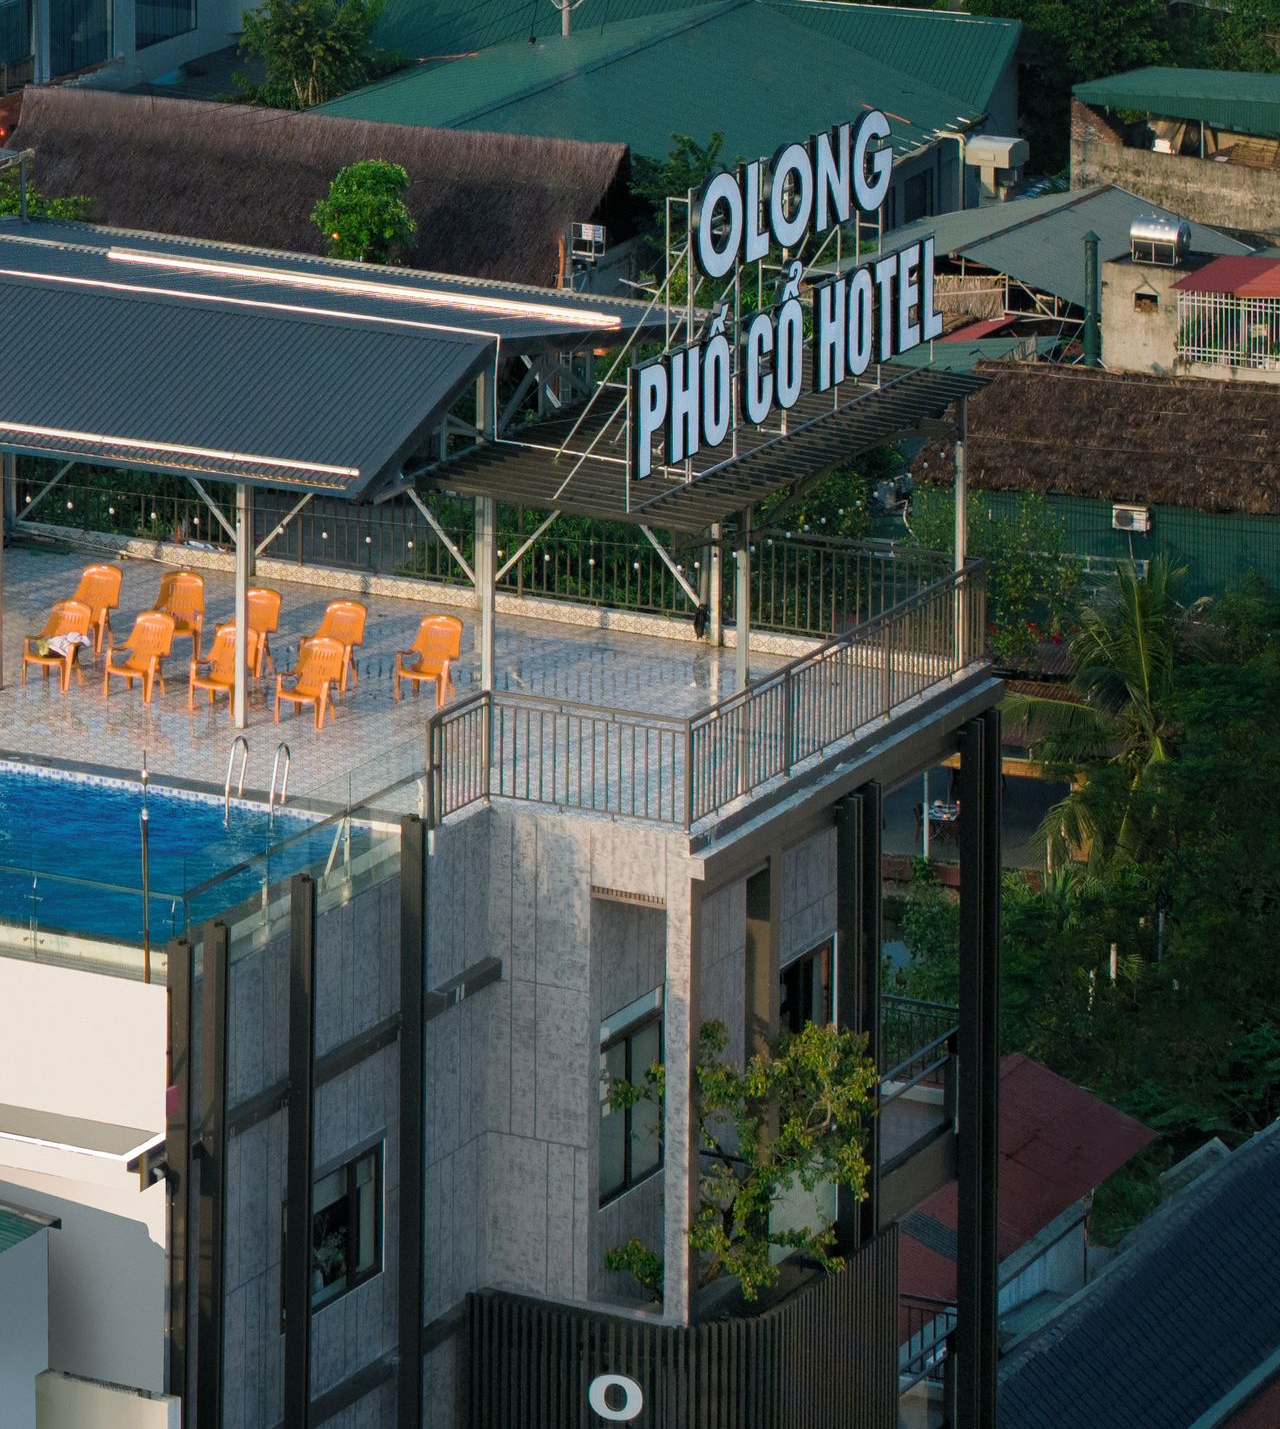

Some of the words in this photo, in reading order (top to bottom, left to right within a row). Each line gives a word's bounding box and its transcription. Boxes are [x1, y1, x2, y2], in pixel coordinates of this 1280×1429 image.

[694, 108, 894, 279] OLONG
[632, 299, 730, 481] PHỐ
[741, 258, 804, 425] CỔ
[814, 234, 943, 393] HOTEL
[588, 1373, 644, 1421] O
